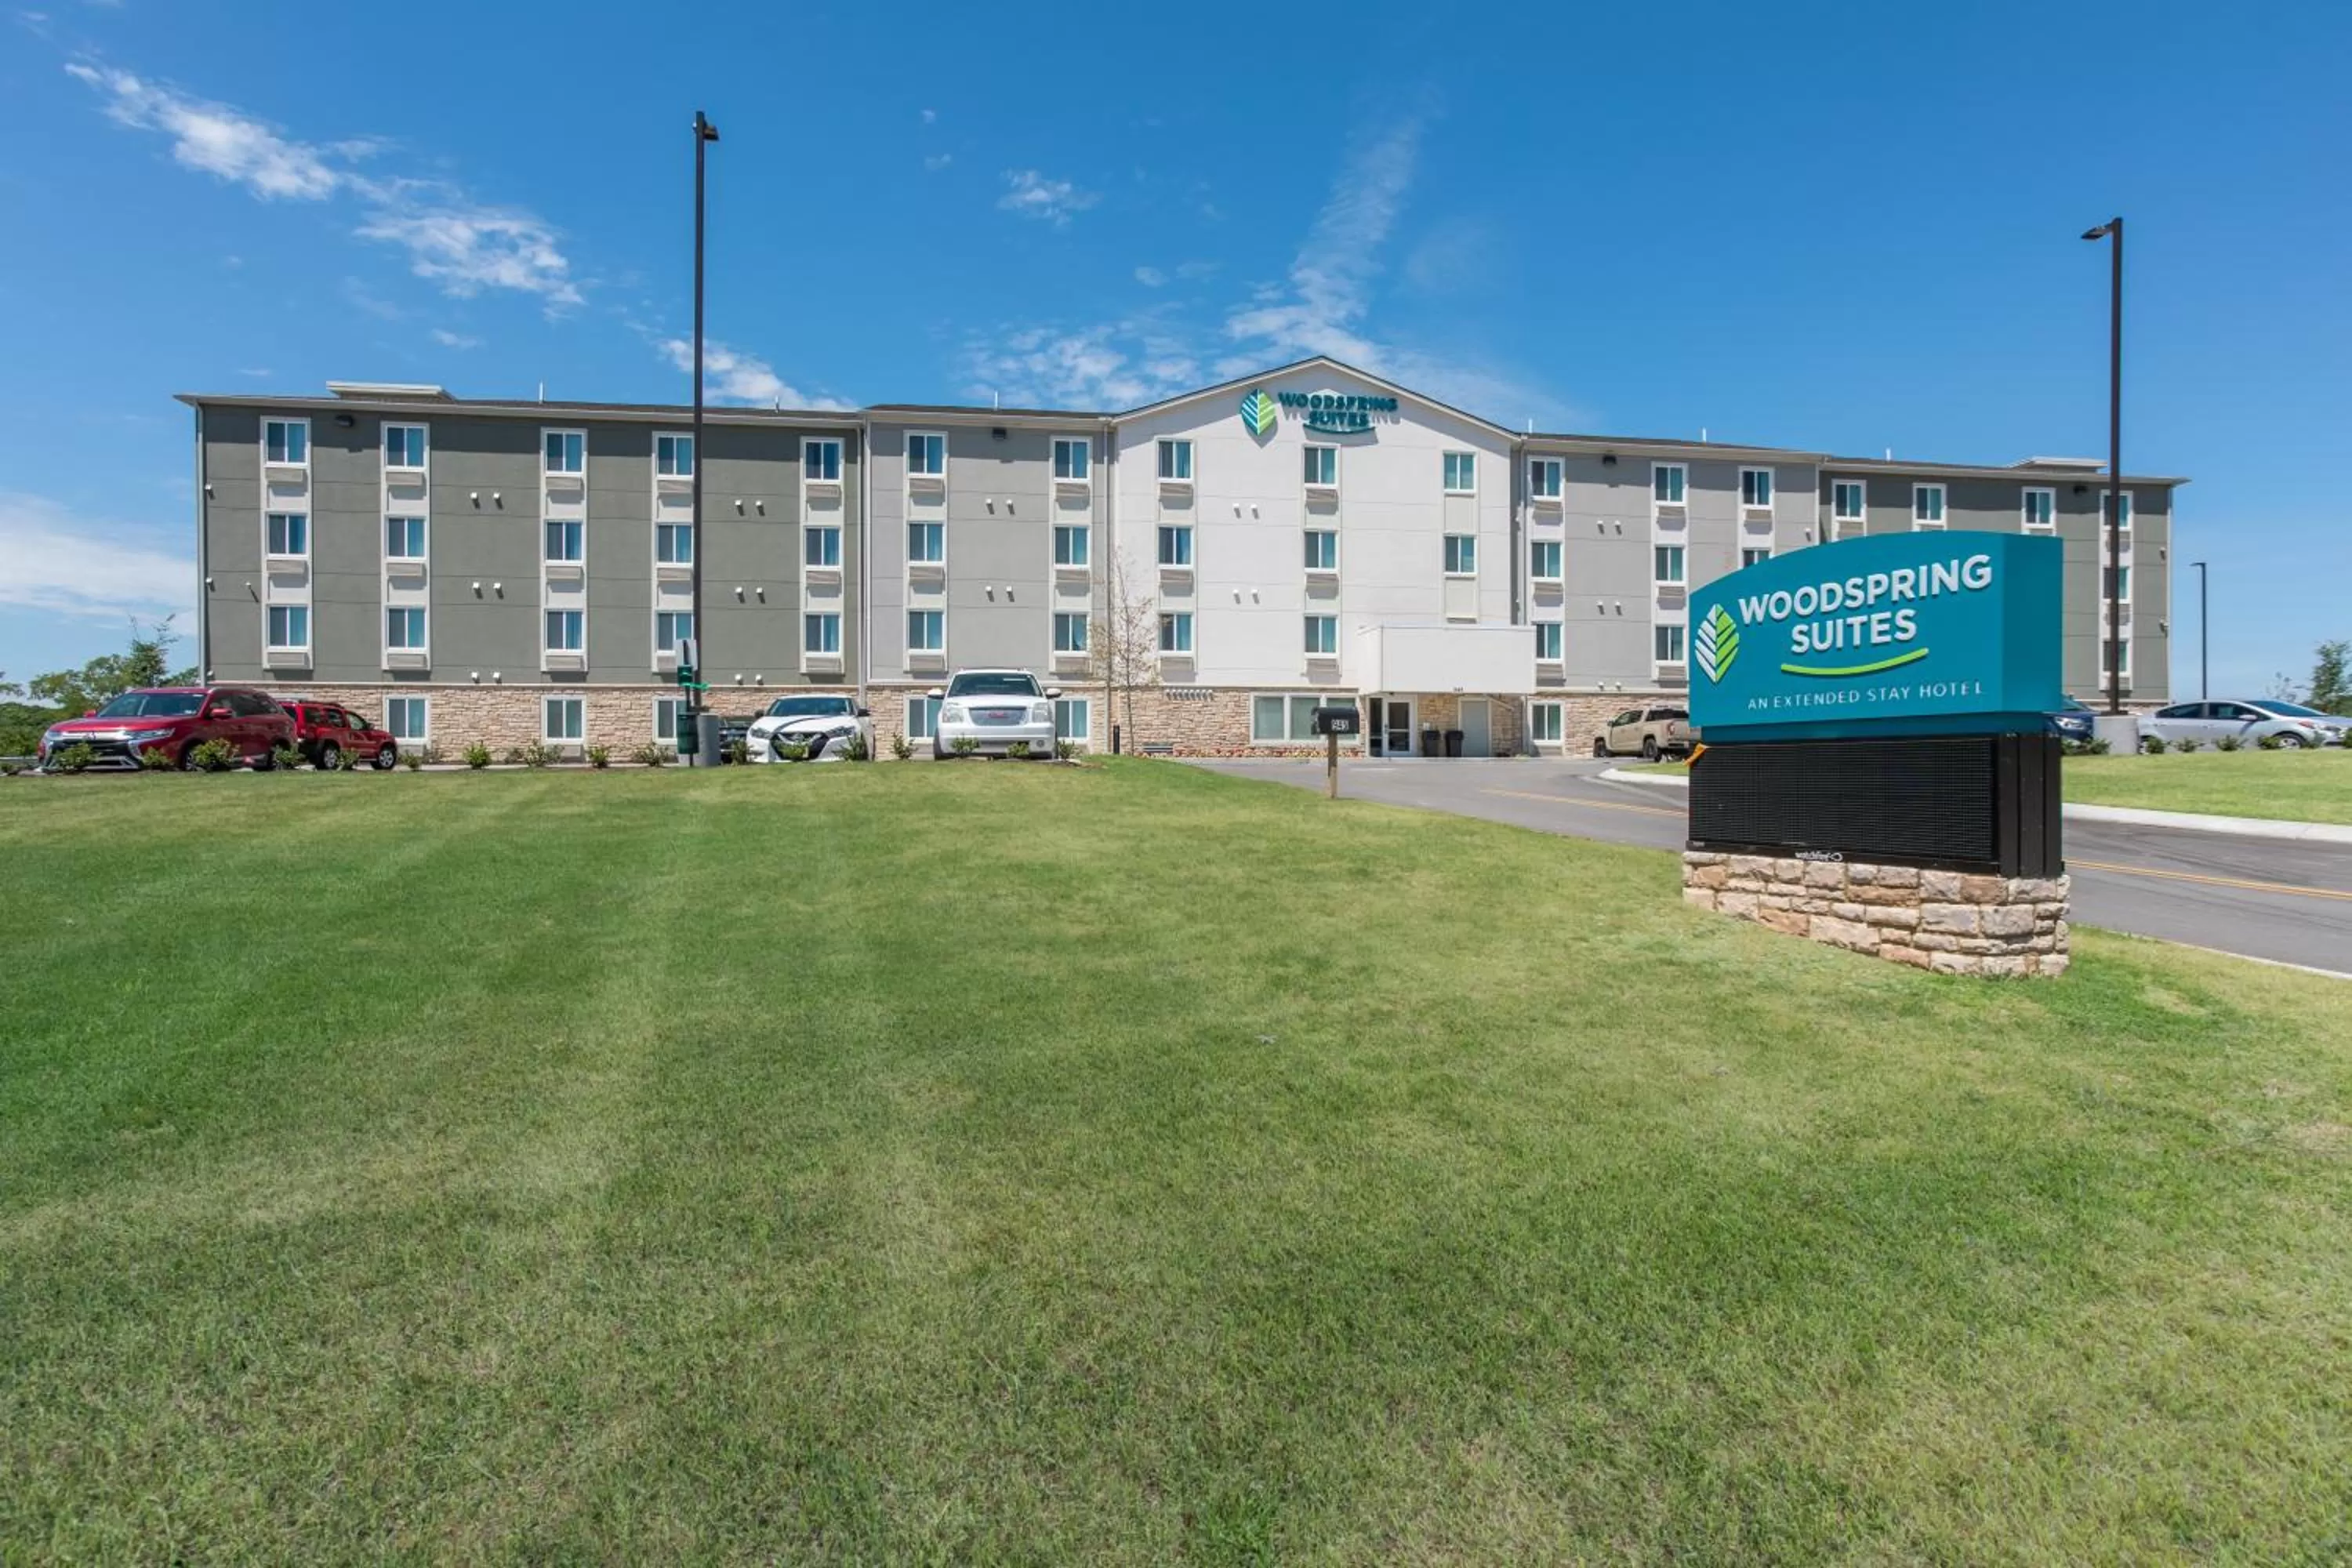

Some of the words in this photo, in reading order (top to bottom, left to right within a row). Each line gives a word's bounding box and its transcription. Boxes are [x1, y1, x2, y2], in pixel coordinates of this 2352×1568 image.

[1278, 392, 1398, 412] WOODSPRING
[1309, 411, 1369, 426] SUITES
[1738, 554, 1992, 625] WOODSPRING
[1791, 608, 1917, 654] SUITES
[1748, 698, 1768, 710] AN
[1774, 690, 1860, 708] EXTENDED
[1867, 687, 1911, 702] STAY
[1919, 681, 1983, 698] HOTEL
